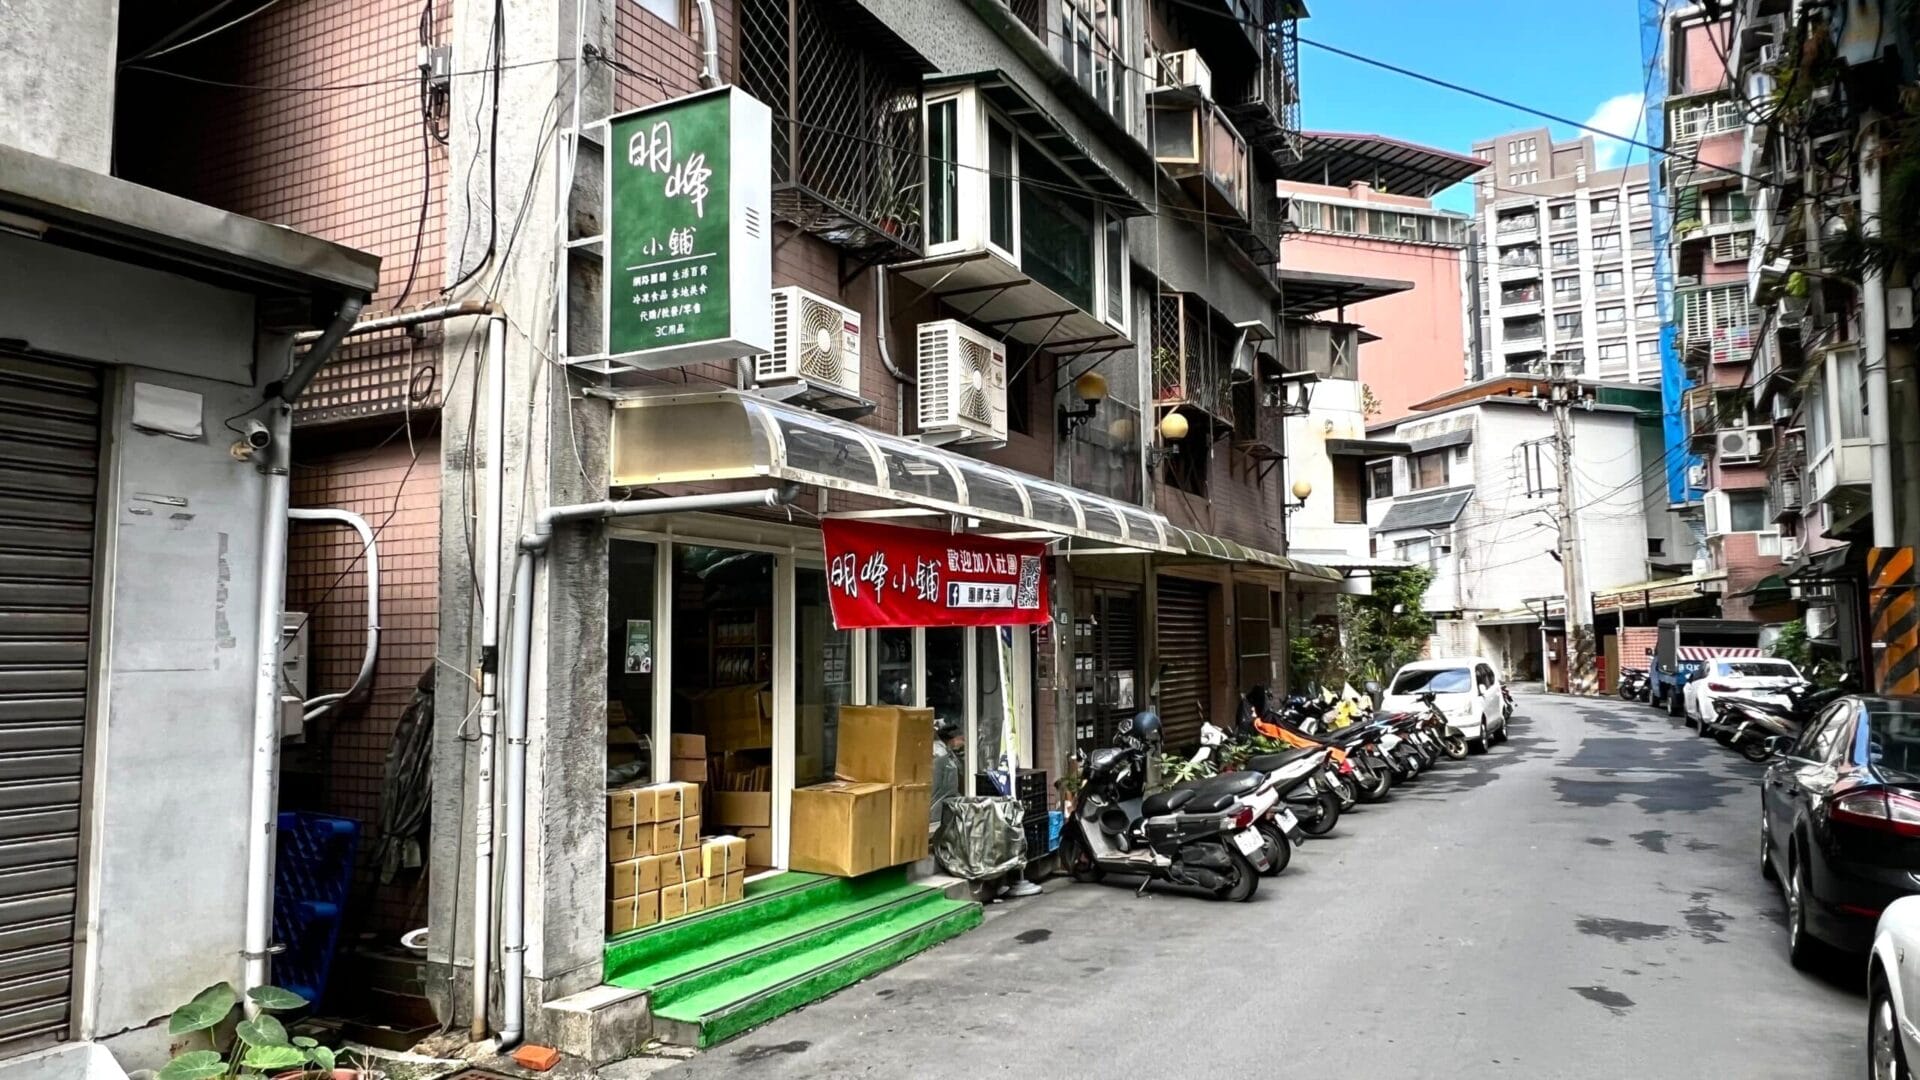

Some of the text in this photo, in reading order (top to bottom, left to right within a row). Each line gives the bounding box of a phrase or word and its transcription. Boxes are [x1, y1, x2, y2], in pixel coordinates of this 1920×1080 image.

[628, 121, 713, 218] 明峰
[672, 265, 708, 281] 生活百貨
[632, 289, 668, 305] 冷凍食品
[655, 323, 685, 337] 3C用品
[947, 549, 1018, 575] 歡迎加入社團
